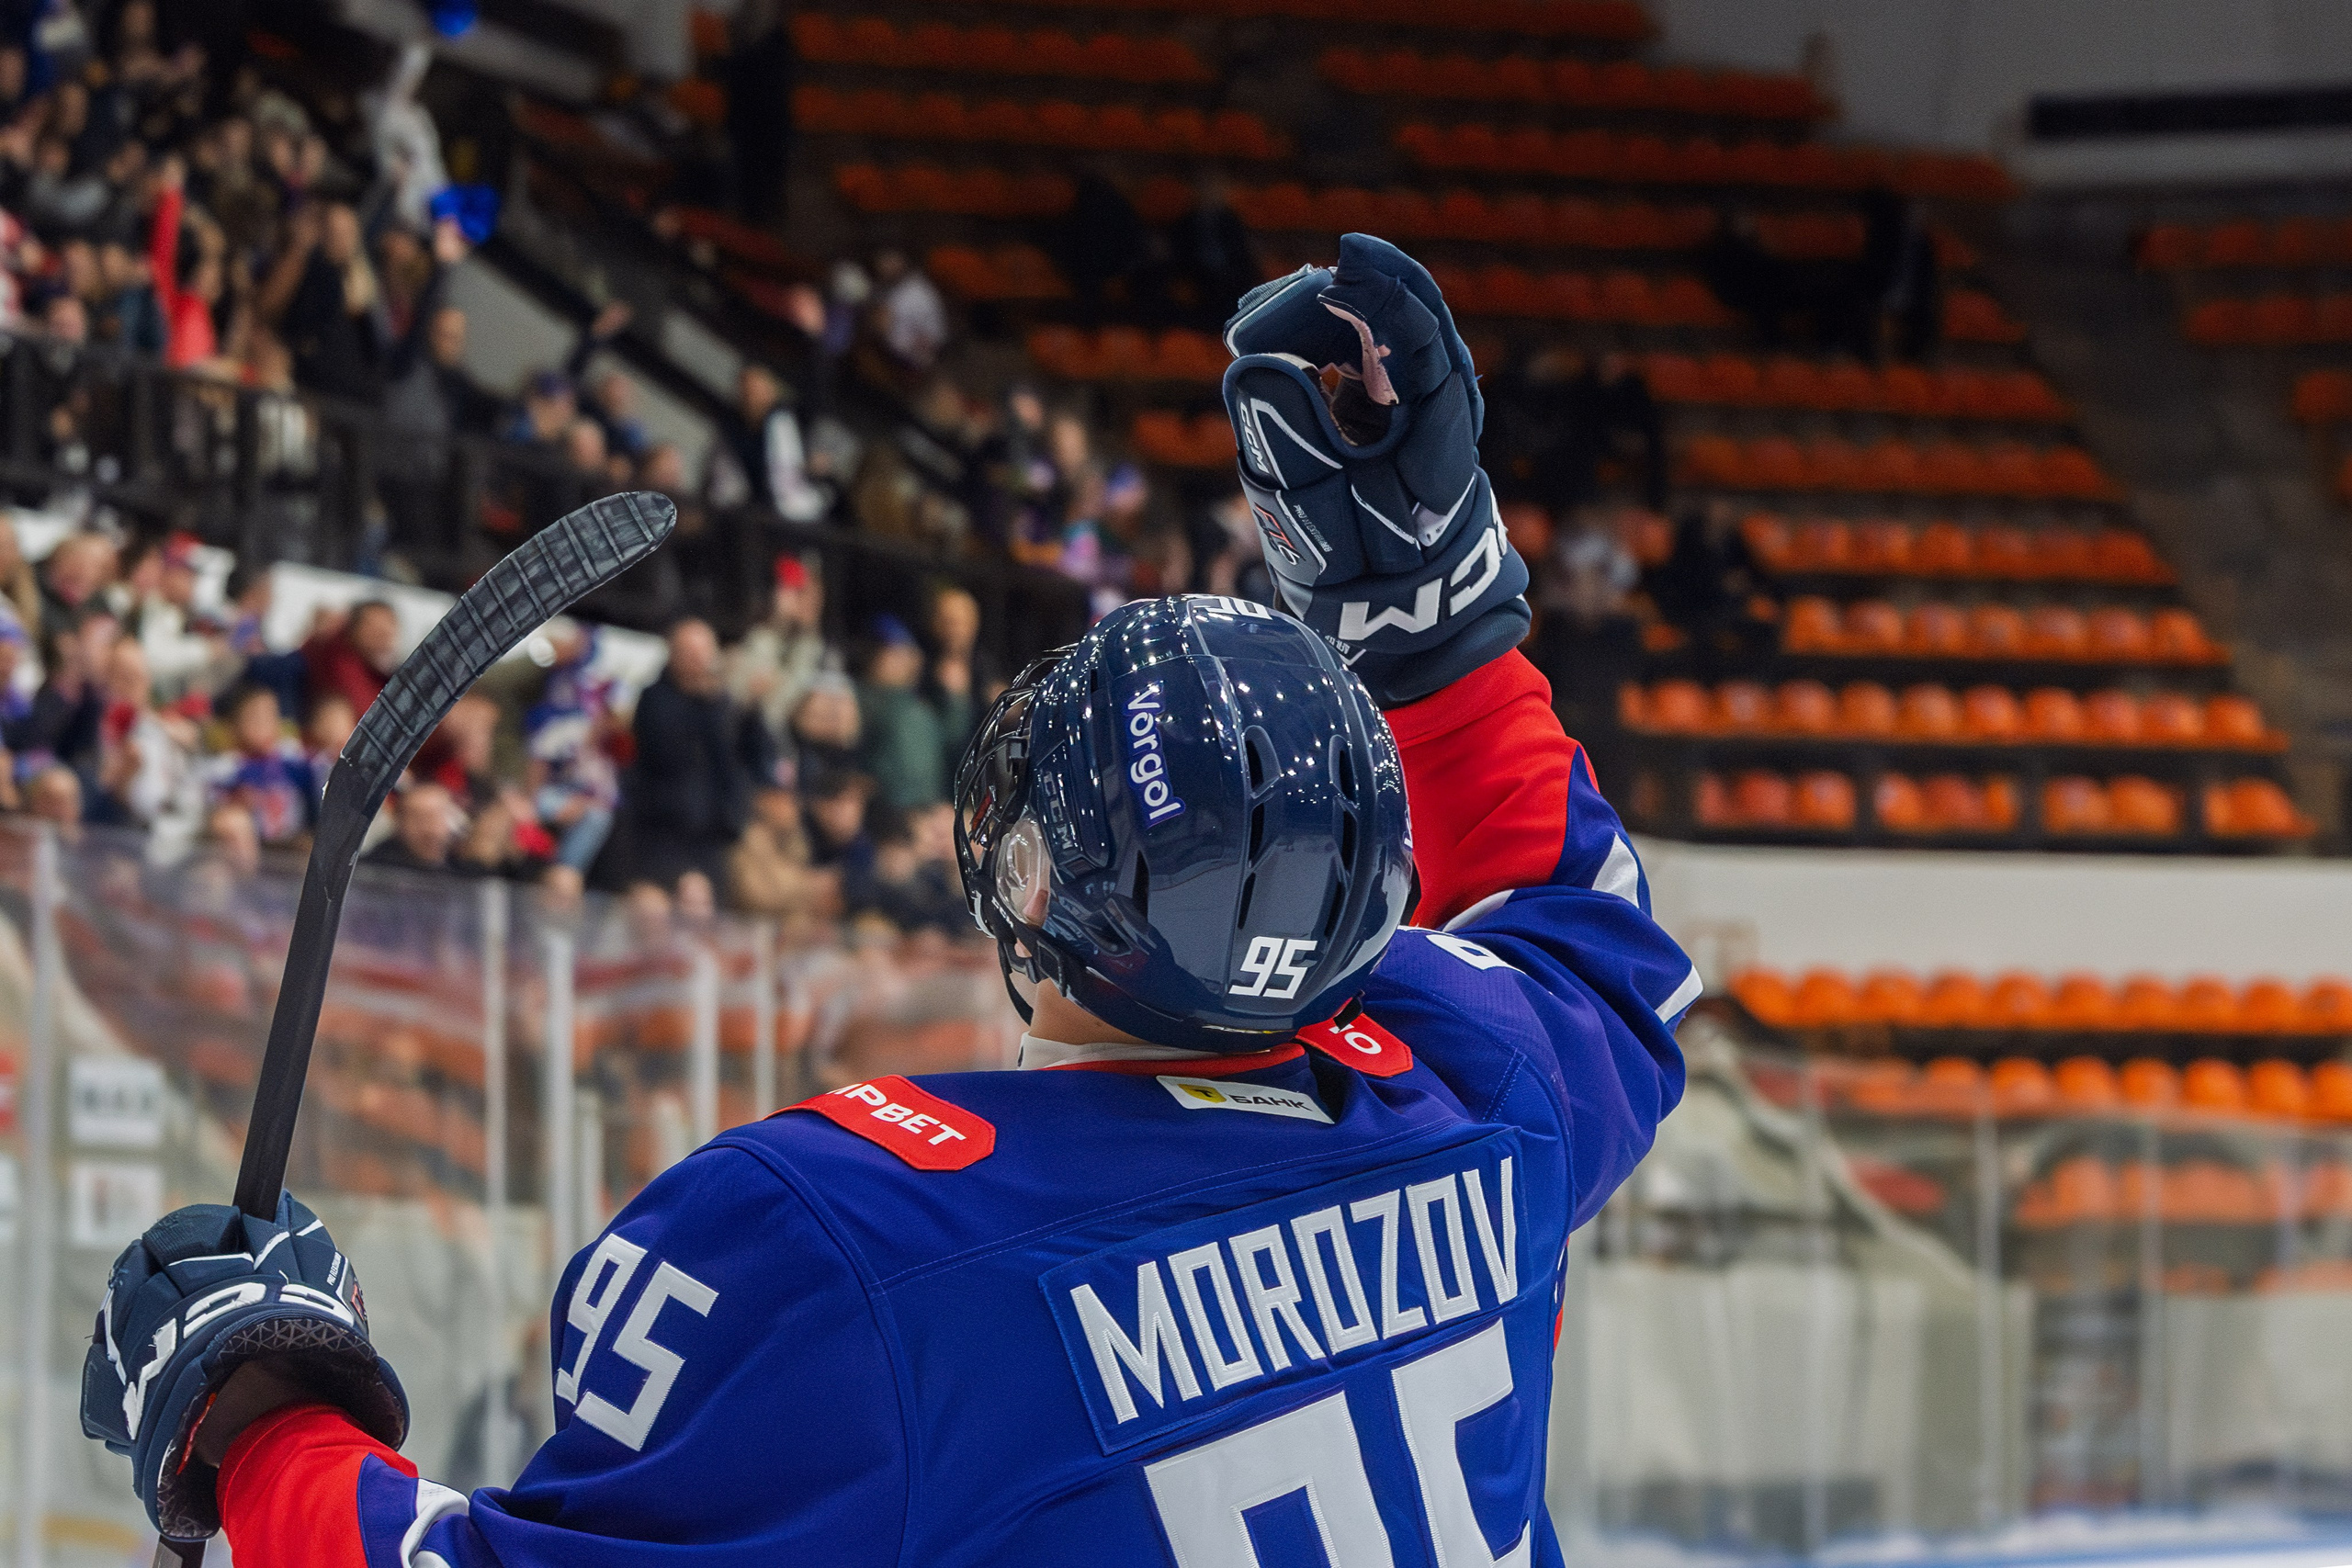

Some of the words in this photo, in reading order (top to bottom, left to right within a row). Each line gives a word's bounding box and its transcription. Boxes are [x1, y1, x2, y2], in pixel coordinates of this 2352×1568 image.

[1240, 401, 1270, 474] CCM
[1127, 683, 1182, 820] Vorgol
[1228, 936, 1317, 999] 95
[1228, 1094, 1313, 1112] БАНК
[556, 1233, 719, 1451] 95
[1069, 1156, 1519, 1424] MOROZOV
